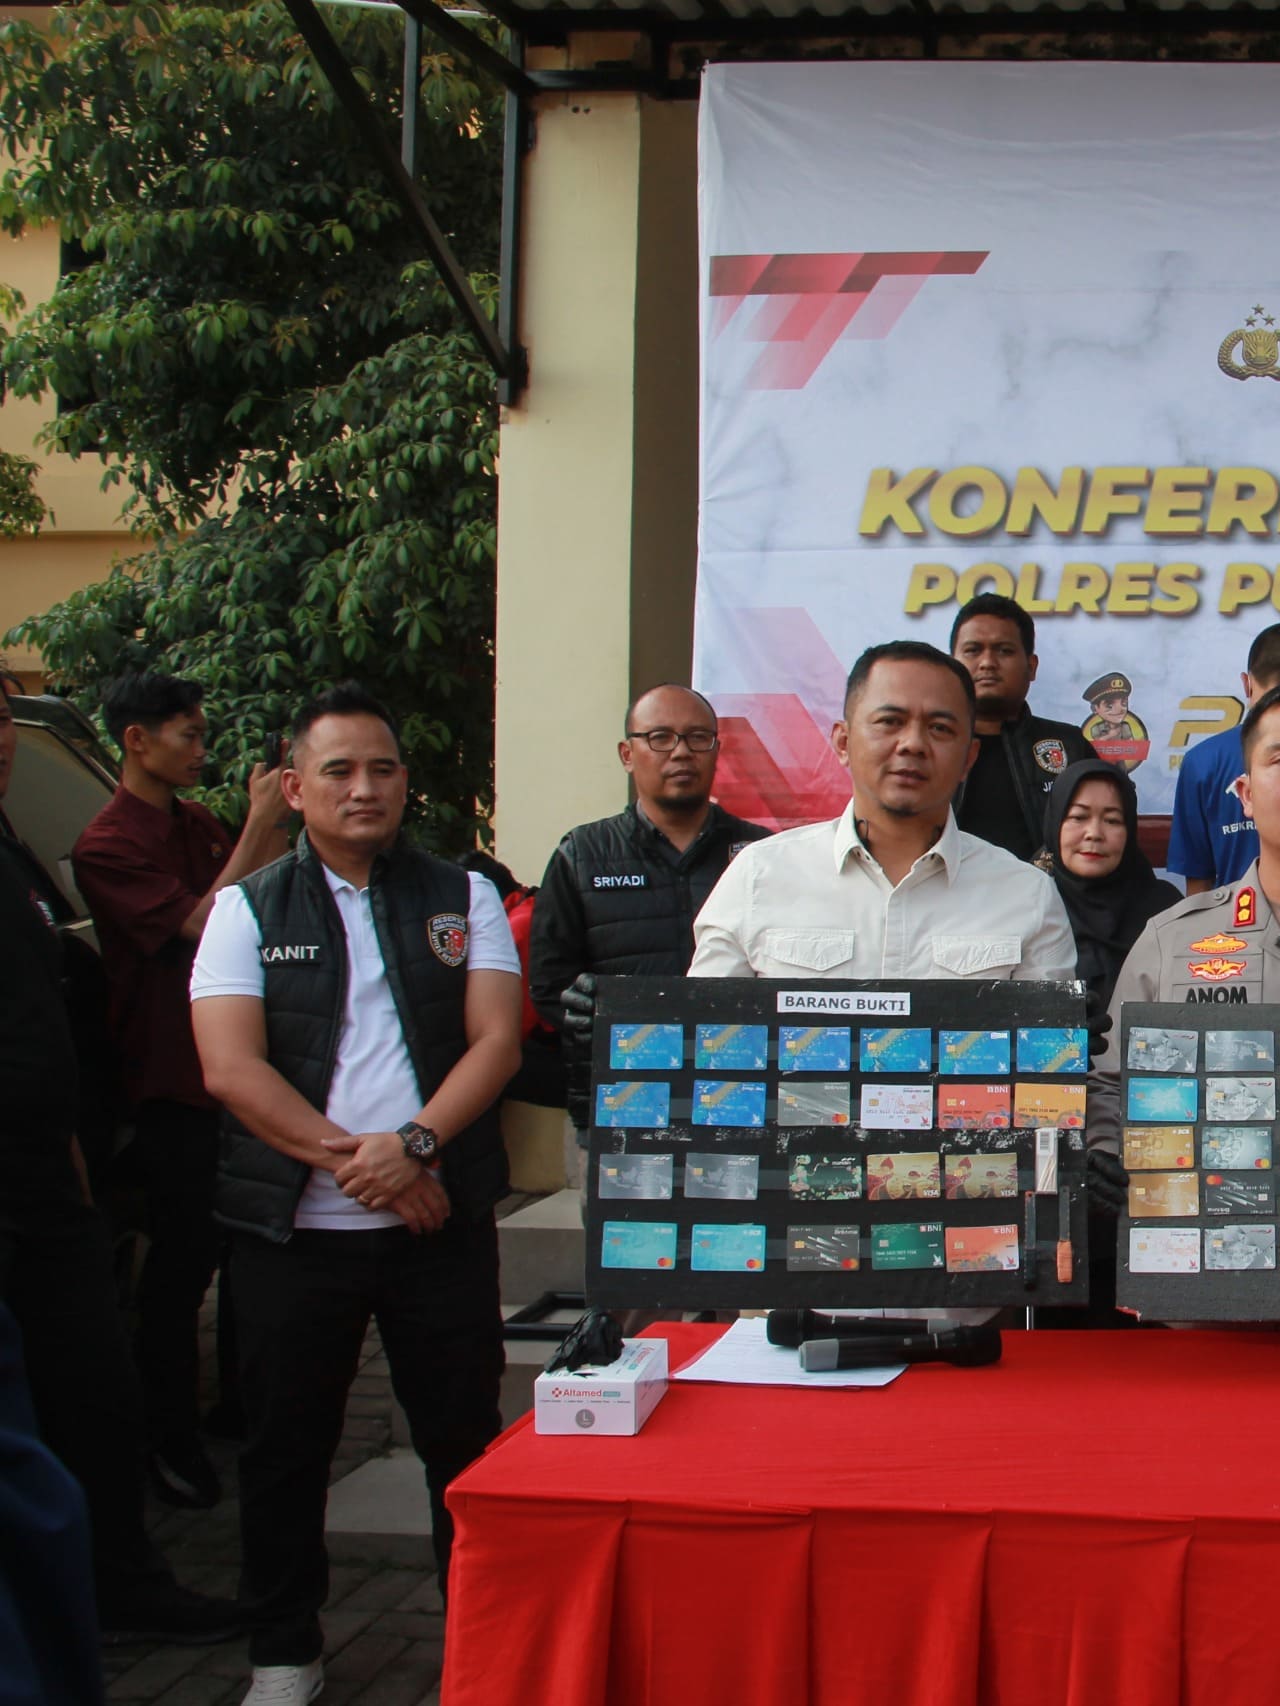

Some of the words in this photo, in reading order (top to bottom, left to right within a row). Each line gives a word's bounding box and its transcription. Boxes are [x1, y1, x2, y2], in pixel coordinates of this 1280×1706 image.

[904, 562, 1200, 618] POLRES
[593, 874, 645, 888] SRIYADI
[261, 944, 320, 962] KANIT
[785, 995, 851, 1010] BARANG
[856, 999, 906, 1012] BUKTI
[1185, 985, 1249, 1005] ANOM
[926, 1224, 942, 1232] BNI
[563, 1389, 602, 1398] Altamed
